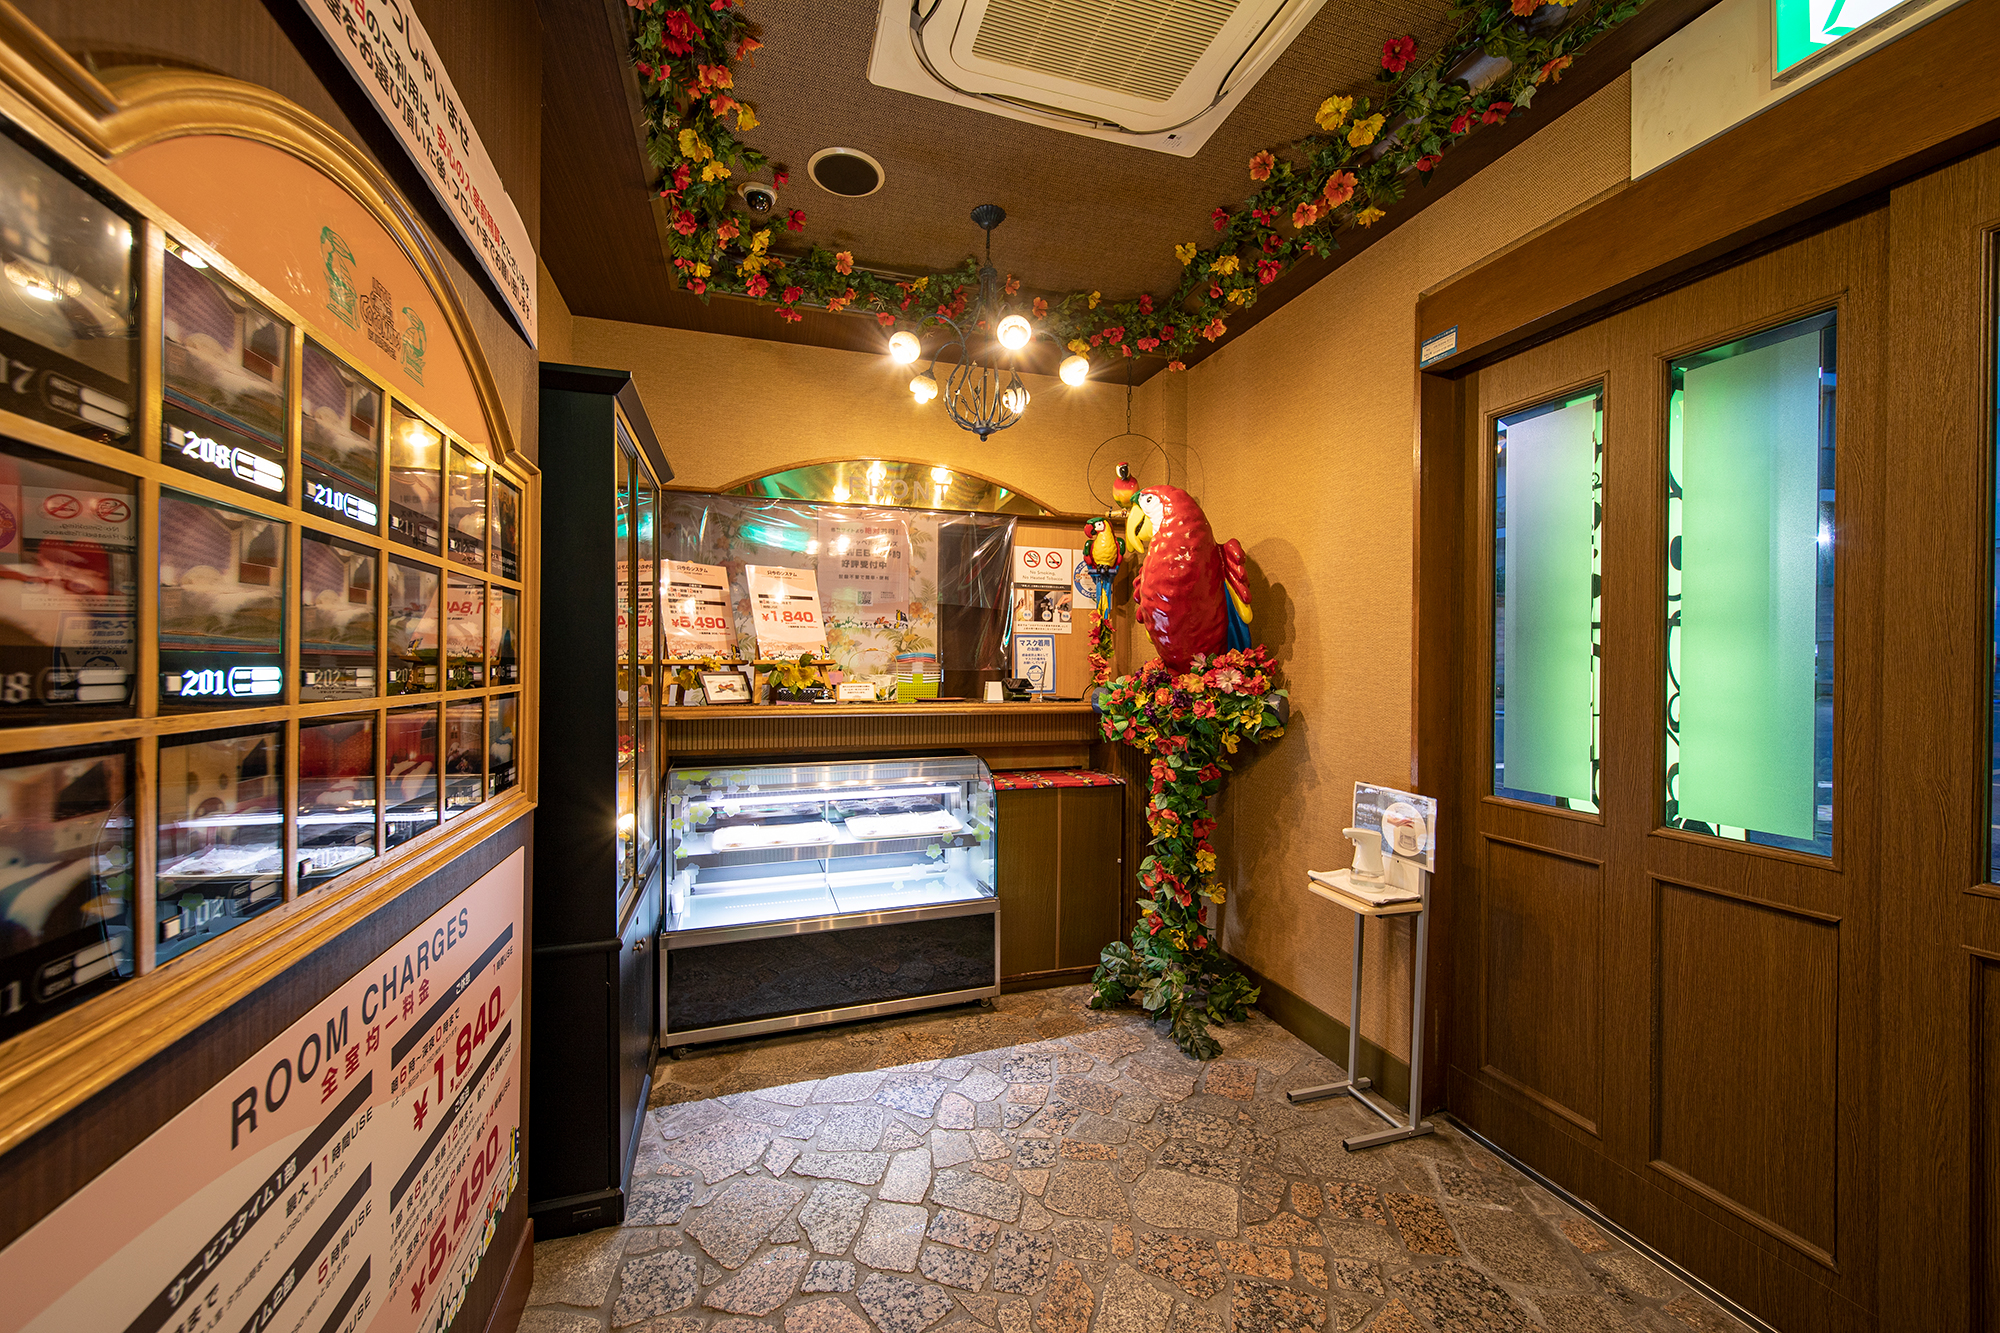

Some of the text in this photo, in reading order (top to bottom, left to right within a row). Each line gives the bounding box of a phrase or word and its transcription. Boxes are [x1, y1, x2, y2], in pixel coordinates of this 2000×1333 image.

[380, 0, 470, 157] っしゃいませ
[182, 430, 232, 469] 208
[313, 483, 346, 513] 210
[849, 476, 950, 501] FRONT
[671, 615, 727, 629] ¥5,490
[762, 611, 814, 623] ¥1,840
[1019, 639, 1051, 647] マスク着用
[181, 668, 229, 697] 201
[315, 668, 342, 688] 202
[231, 907, 468, 1151] ROOM CHARGES
[320, 978, 430, 1105] 全室均一料金
[413, 985, 501, 1133] ¥1,840
[285, 1105, 374, 1219] 最大11時間USE
[167, 1156, 298, 1308] サービスタイム1部
[317, 1199, 373, 1286] 5時間USE
[411, 1124, 499, 1315] ¥5,490
